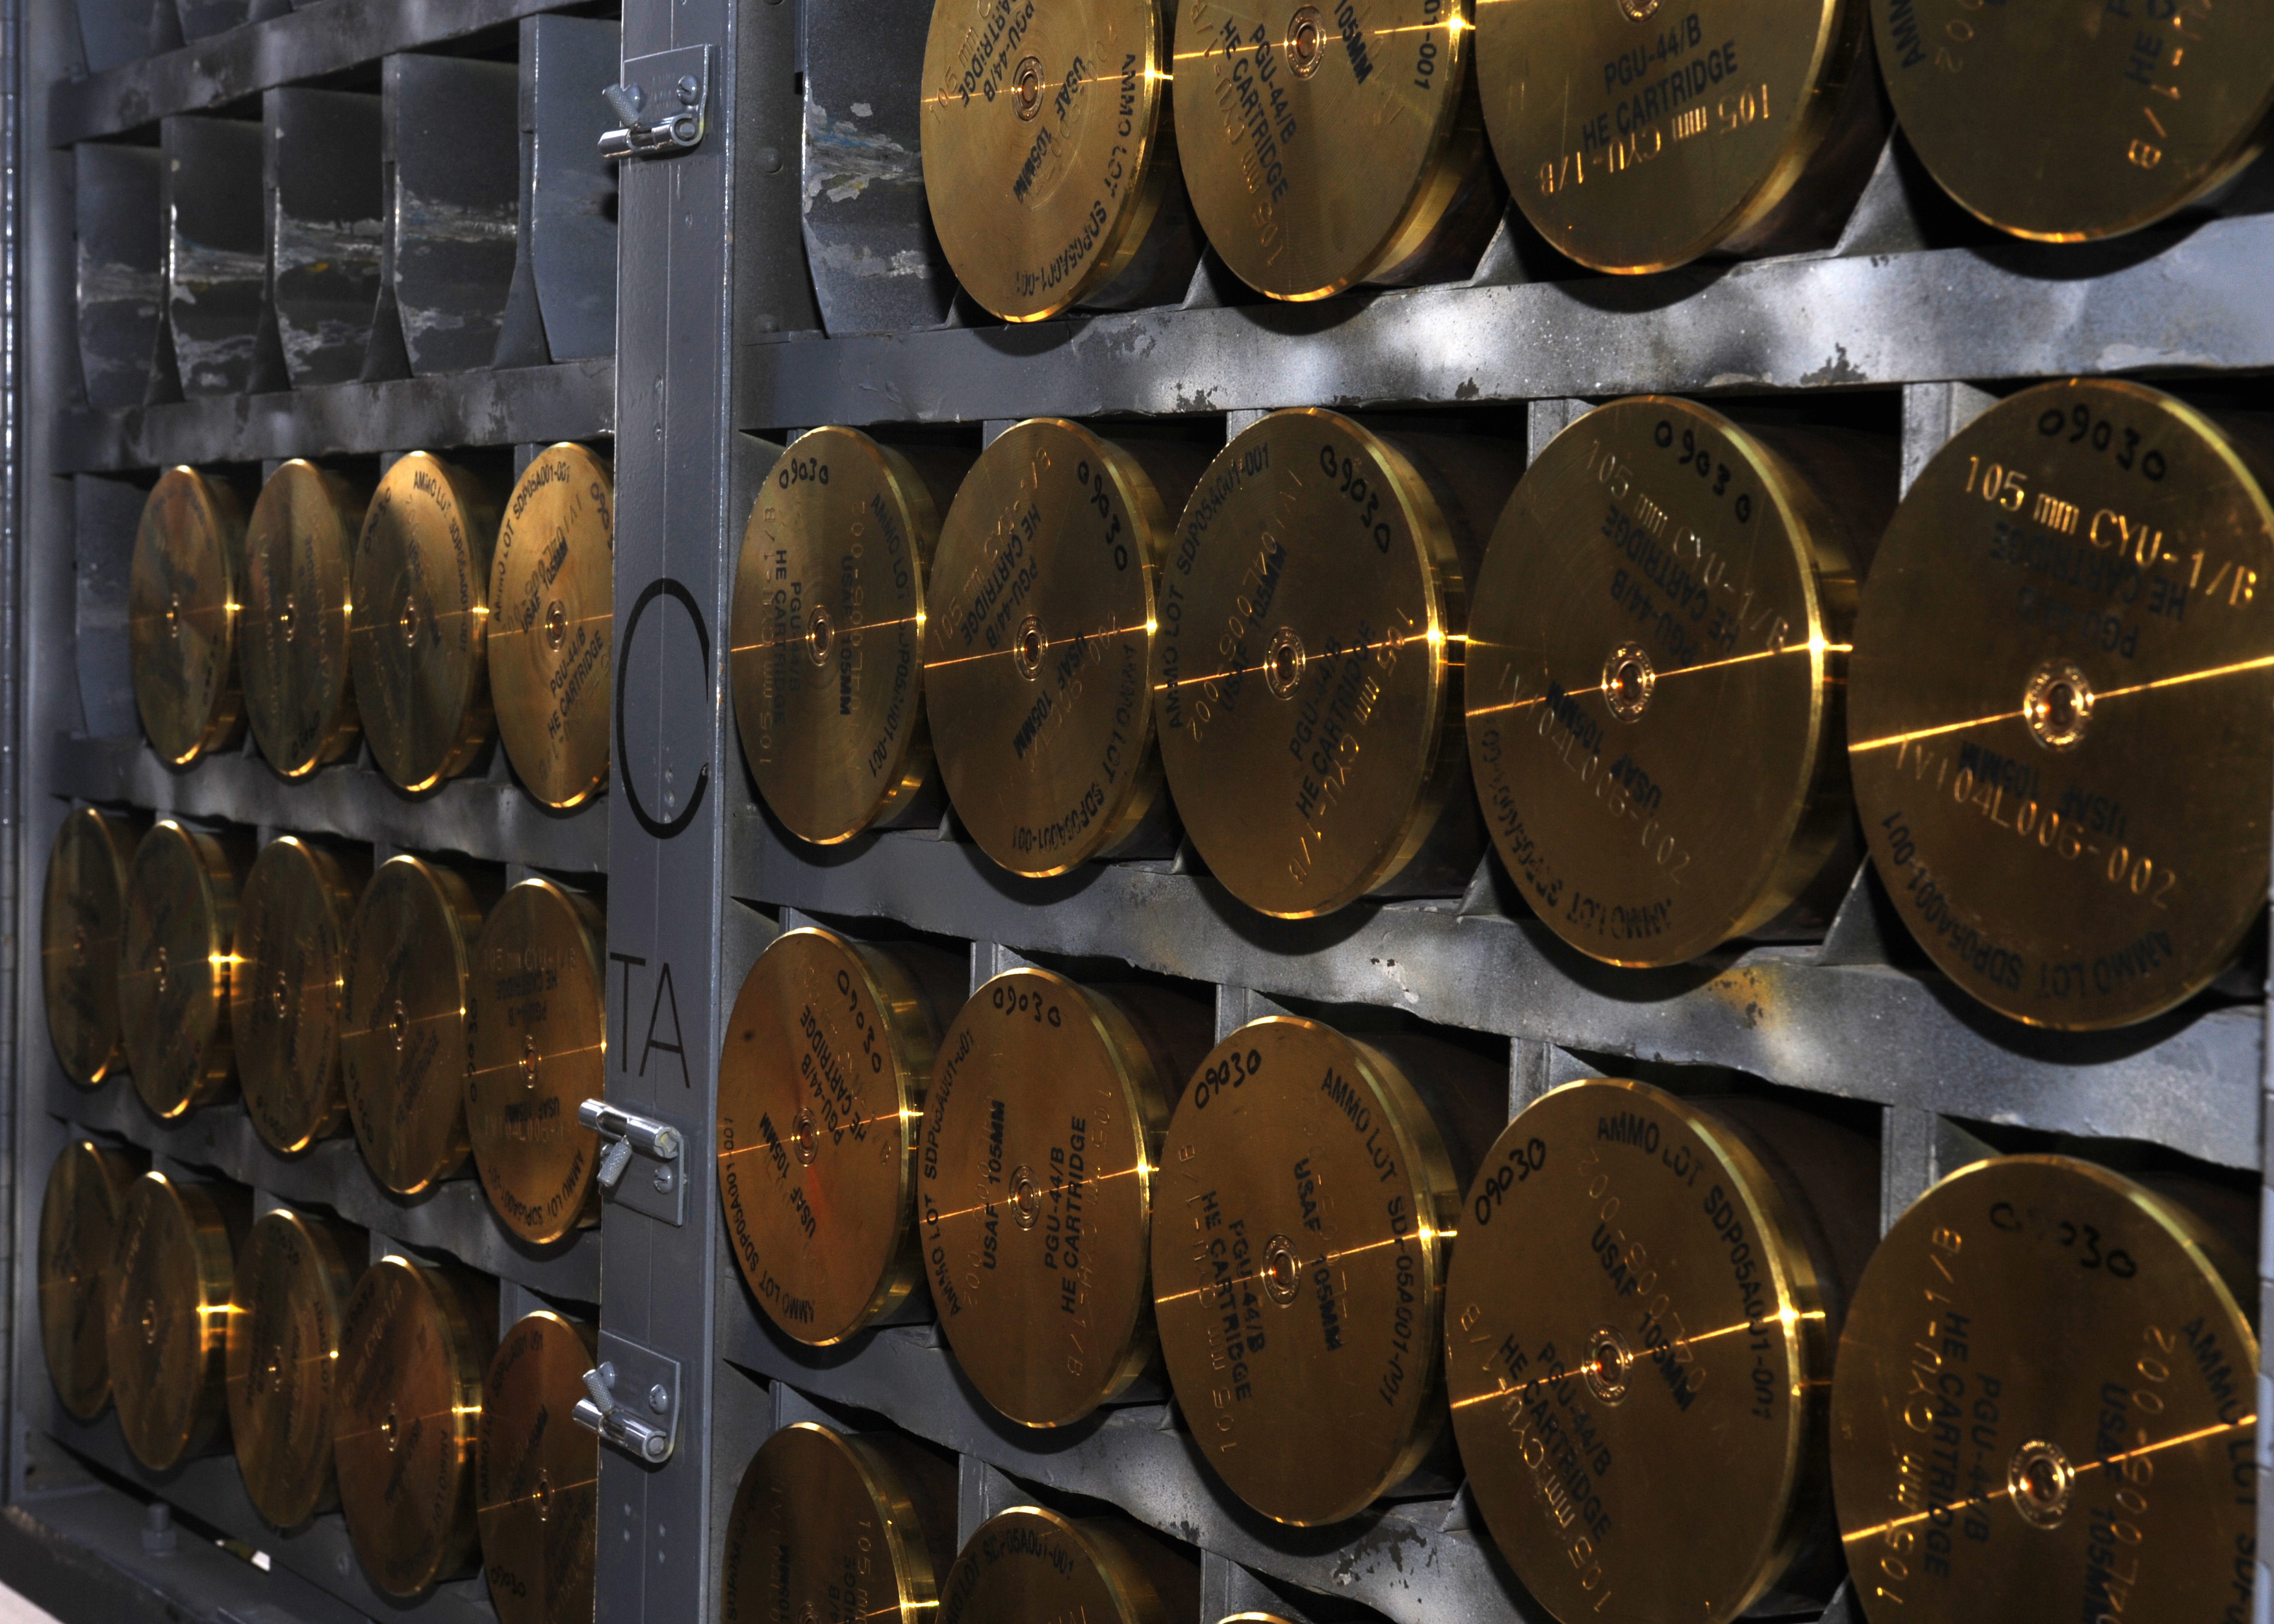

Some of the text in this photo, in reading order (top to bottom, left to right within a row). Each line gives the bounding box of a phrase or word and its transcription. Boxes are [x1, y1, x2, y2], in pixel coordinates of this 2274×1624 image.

[959, 0, 1011, 108] ARTRIDGE
[1603, 12, 1702, 95] PGU-44/B
[1888, 0, 1926, 70] AMM
[1580, 40, 1739, 154] HE CARTRIDGE
[779, 457, 829, 490] 09030
[2036, 402, 2168, 483] 09030
[1965, 455, 2030, 513] 105
[2089, 506, 2257, 610] CYU-1/B
[991, 985, 1063, 1029] 09030
[1194, 1047, 1263, 1111] 09030
[1320, 1067, 1372, 1136] AMMO
[1597, 1112, 1661, 1156] AMMO
[1044, 1145, 1066, 1271] PGU-44/B
[1061, 1115, 1088, 1315] HE CARTRIDGE
[1292, 1157, 1322, 1236] USAF
[1474, 1137, 1547, 1226] 09030
[1591, 1222, 1638, 1299] USAF
[1941, 1310, 1971, 1364] HE
